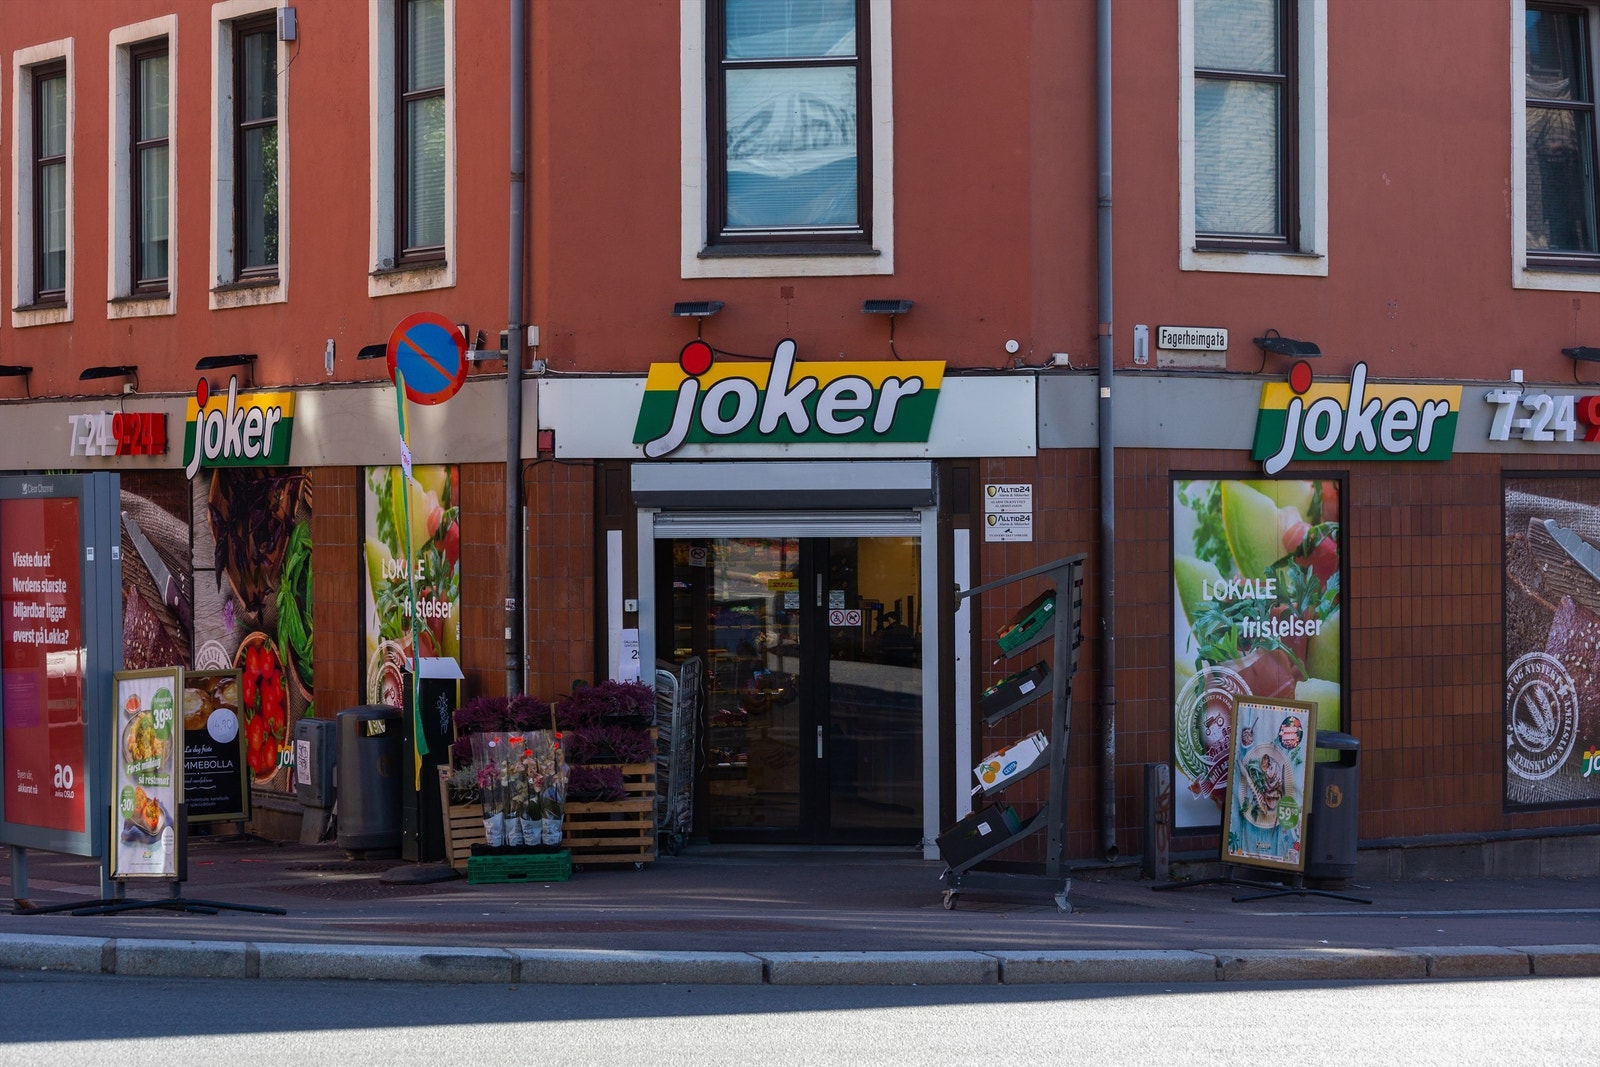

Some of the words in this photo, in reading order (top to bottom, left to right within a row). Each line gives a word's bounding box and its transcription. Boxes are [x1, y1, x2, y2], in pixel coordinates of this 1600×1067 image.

[1161, 329, 1225, 348] Fagerheimgata
[643, 337, 924, 459] joker
[1263, 360, 1450, 476] joker
[1487, 388, 1577, 442] 7-24
[68, 411, 108, 457] 7-24
[112, 412, 156, 456] 9-24
[185, 374, 282, 481] joker
[12, 552, 33, 568] Visste
[33, 552, 42, 568] du
[42, 553, 51, 567] at
[12, 577, 41, 593] Nordens
[41, 578, 67, 593] største
[1202, 578, 1278, 600] LOKALE
[13, 602, 46, 621] biljardbar
[46, 602, 67, 622] ligger
[404, 596, 453, 619] frstelser
[13, 629, 35, 643] øverst
[35, 627, 44, 647] på
[44, 629, 69, 645] Løkka?
[1242, 614, 1323, 638] fristelser
[631, 649, 640, 660] 2
[184, 759, 234, 769] MMEBOLLA
[53, 764, 74, 790] ao
[63, 790, 75, 799] OSLO
